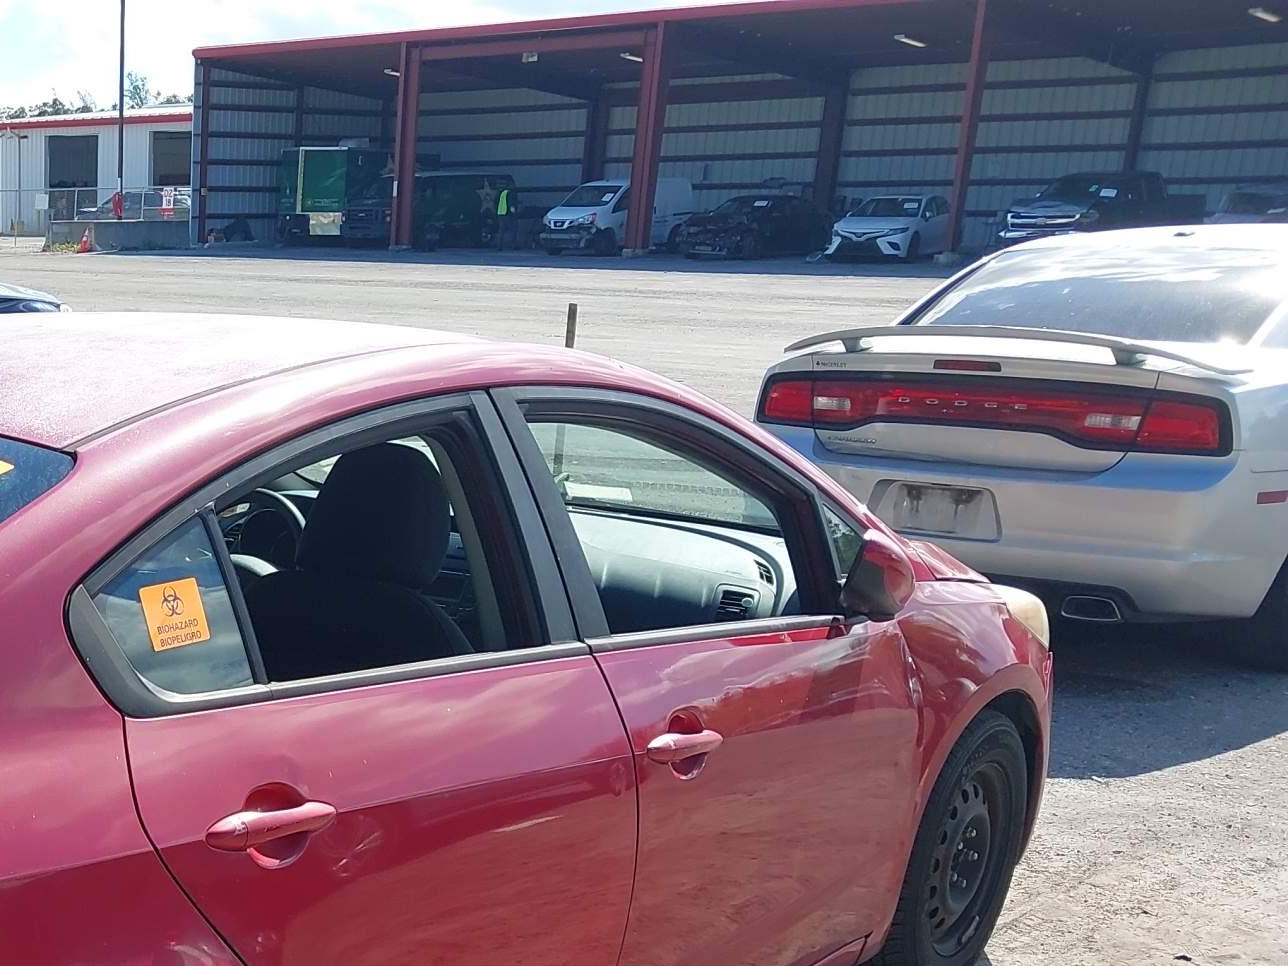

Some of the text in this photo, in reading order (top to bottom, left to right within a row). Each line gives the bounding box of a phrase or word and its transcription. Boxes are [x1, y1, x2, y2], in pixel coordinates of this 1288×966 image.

[897, 396, 1028, 410] DODGE
[156, 618, 199, 635] BIOHAZARD
[159, 630, 202, 648] BIOPELIGRO
